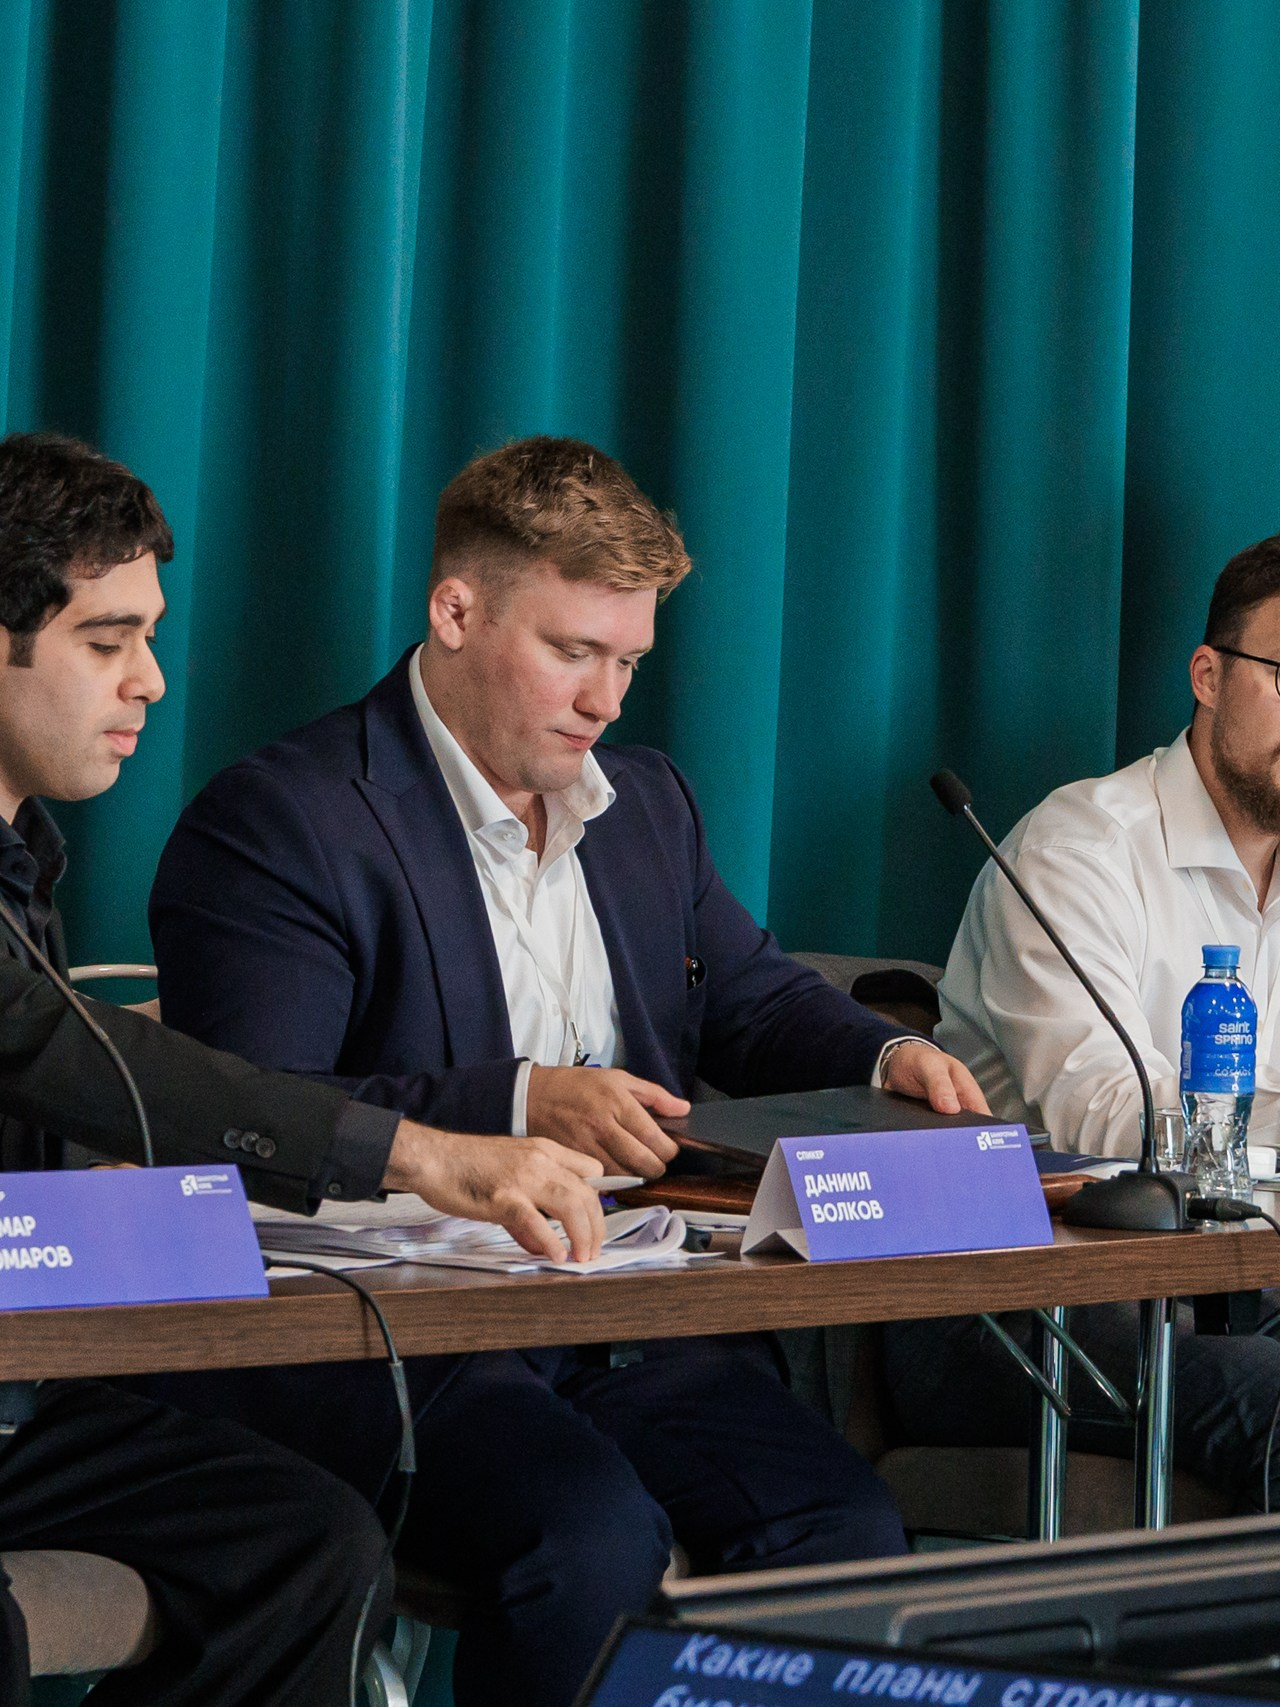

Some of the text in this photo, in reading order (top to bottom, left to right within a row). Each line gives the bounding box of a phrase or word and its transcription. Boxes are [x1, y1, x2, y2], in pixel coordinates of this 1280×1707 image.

[804, 1171, 872, 1198] ДАНИИЛ
[811, 1200, 885, 1223] ВОЛКОВ
[0, 1245, 74, 1270] МАРОВ
[672, 1632, 815, 1688] Какие
[832, 1658, 983, 1706] планы
